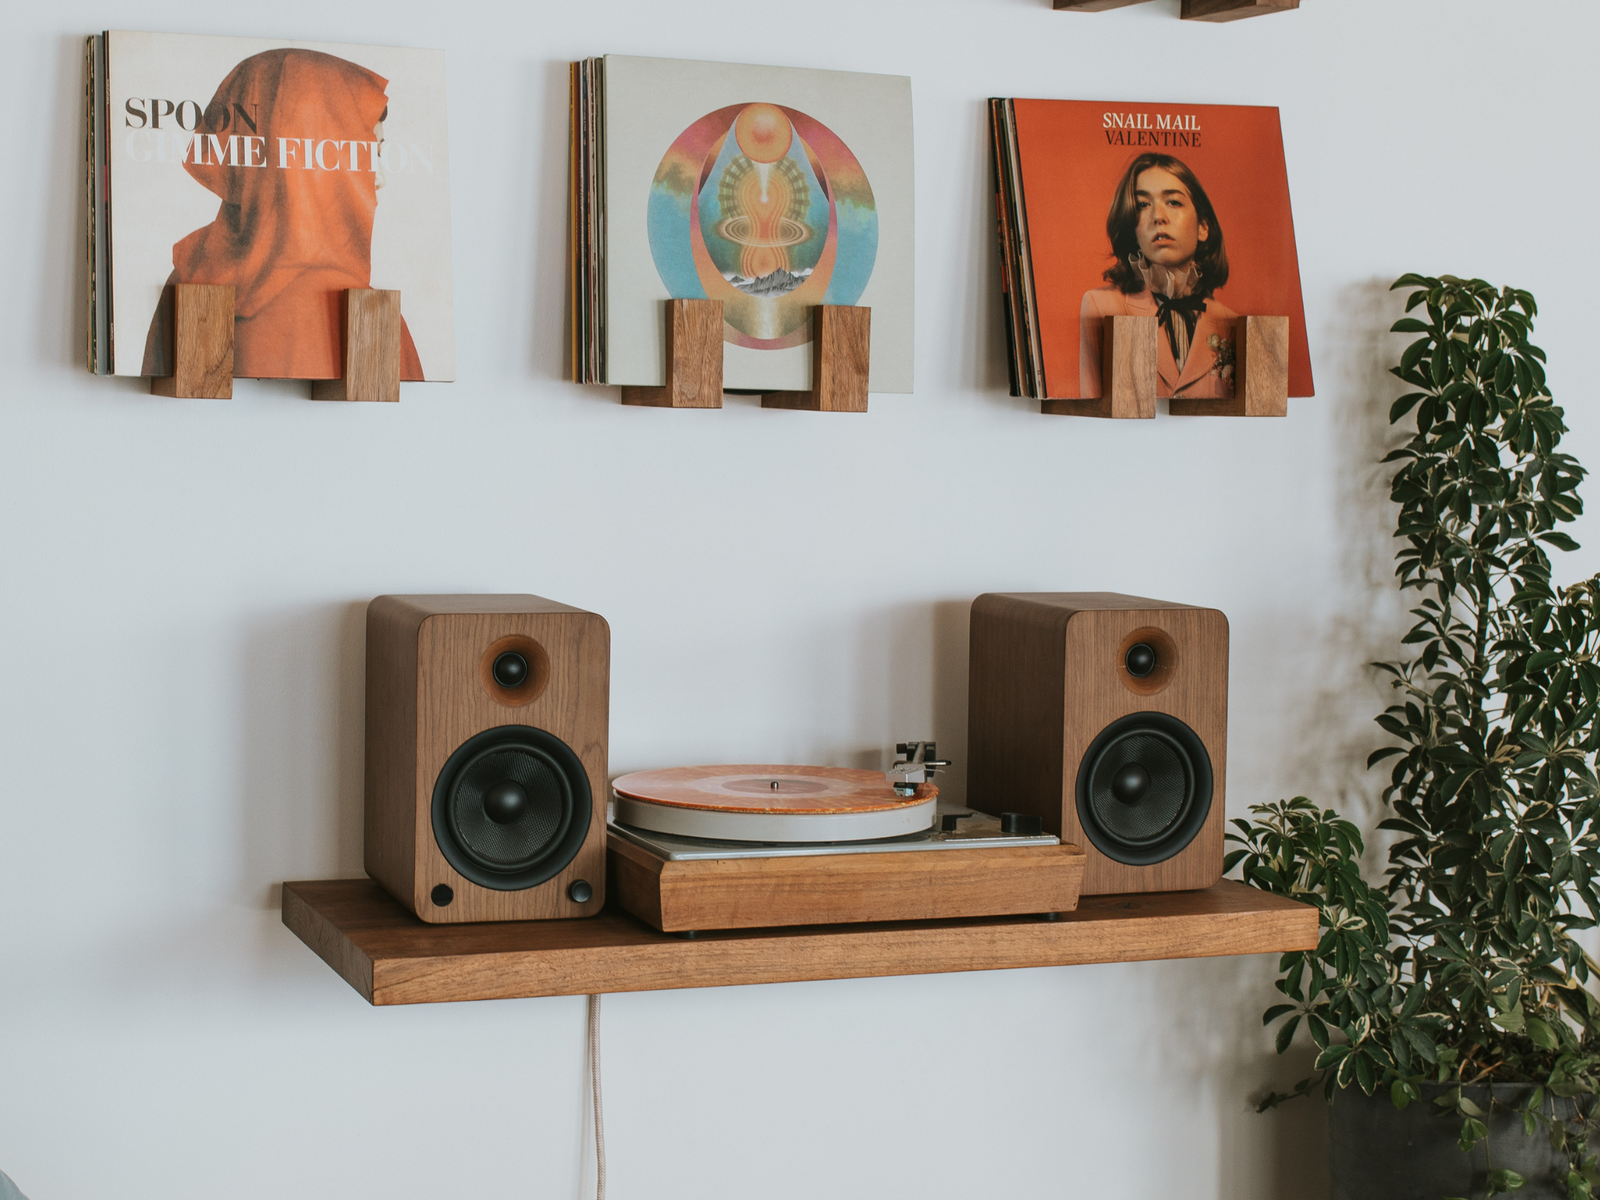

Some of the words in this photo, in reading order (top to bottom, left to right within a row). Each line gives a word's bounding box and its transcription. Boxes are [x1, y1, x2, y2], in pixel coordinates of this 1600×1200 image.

[125, 97, 258, 134] SPOON
[1102, 112, 1153, 129] SNAIL
[1156, 114, 1201, 131] MAIL
[124, 130, 267, 168] GIMME
[276, 136, 434, 175] FICTION
[1105, 130, 1202, 147] VALENTINE
